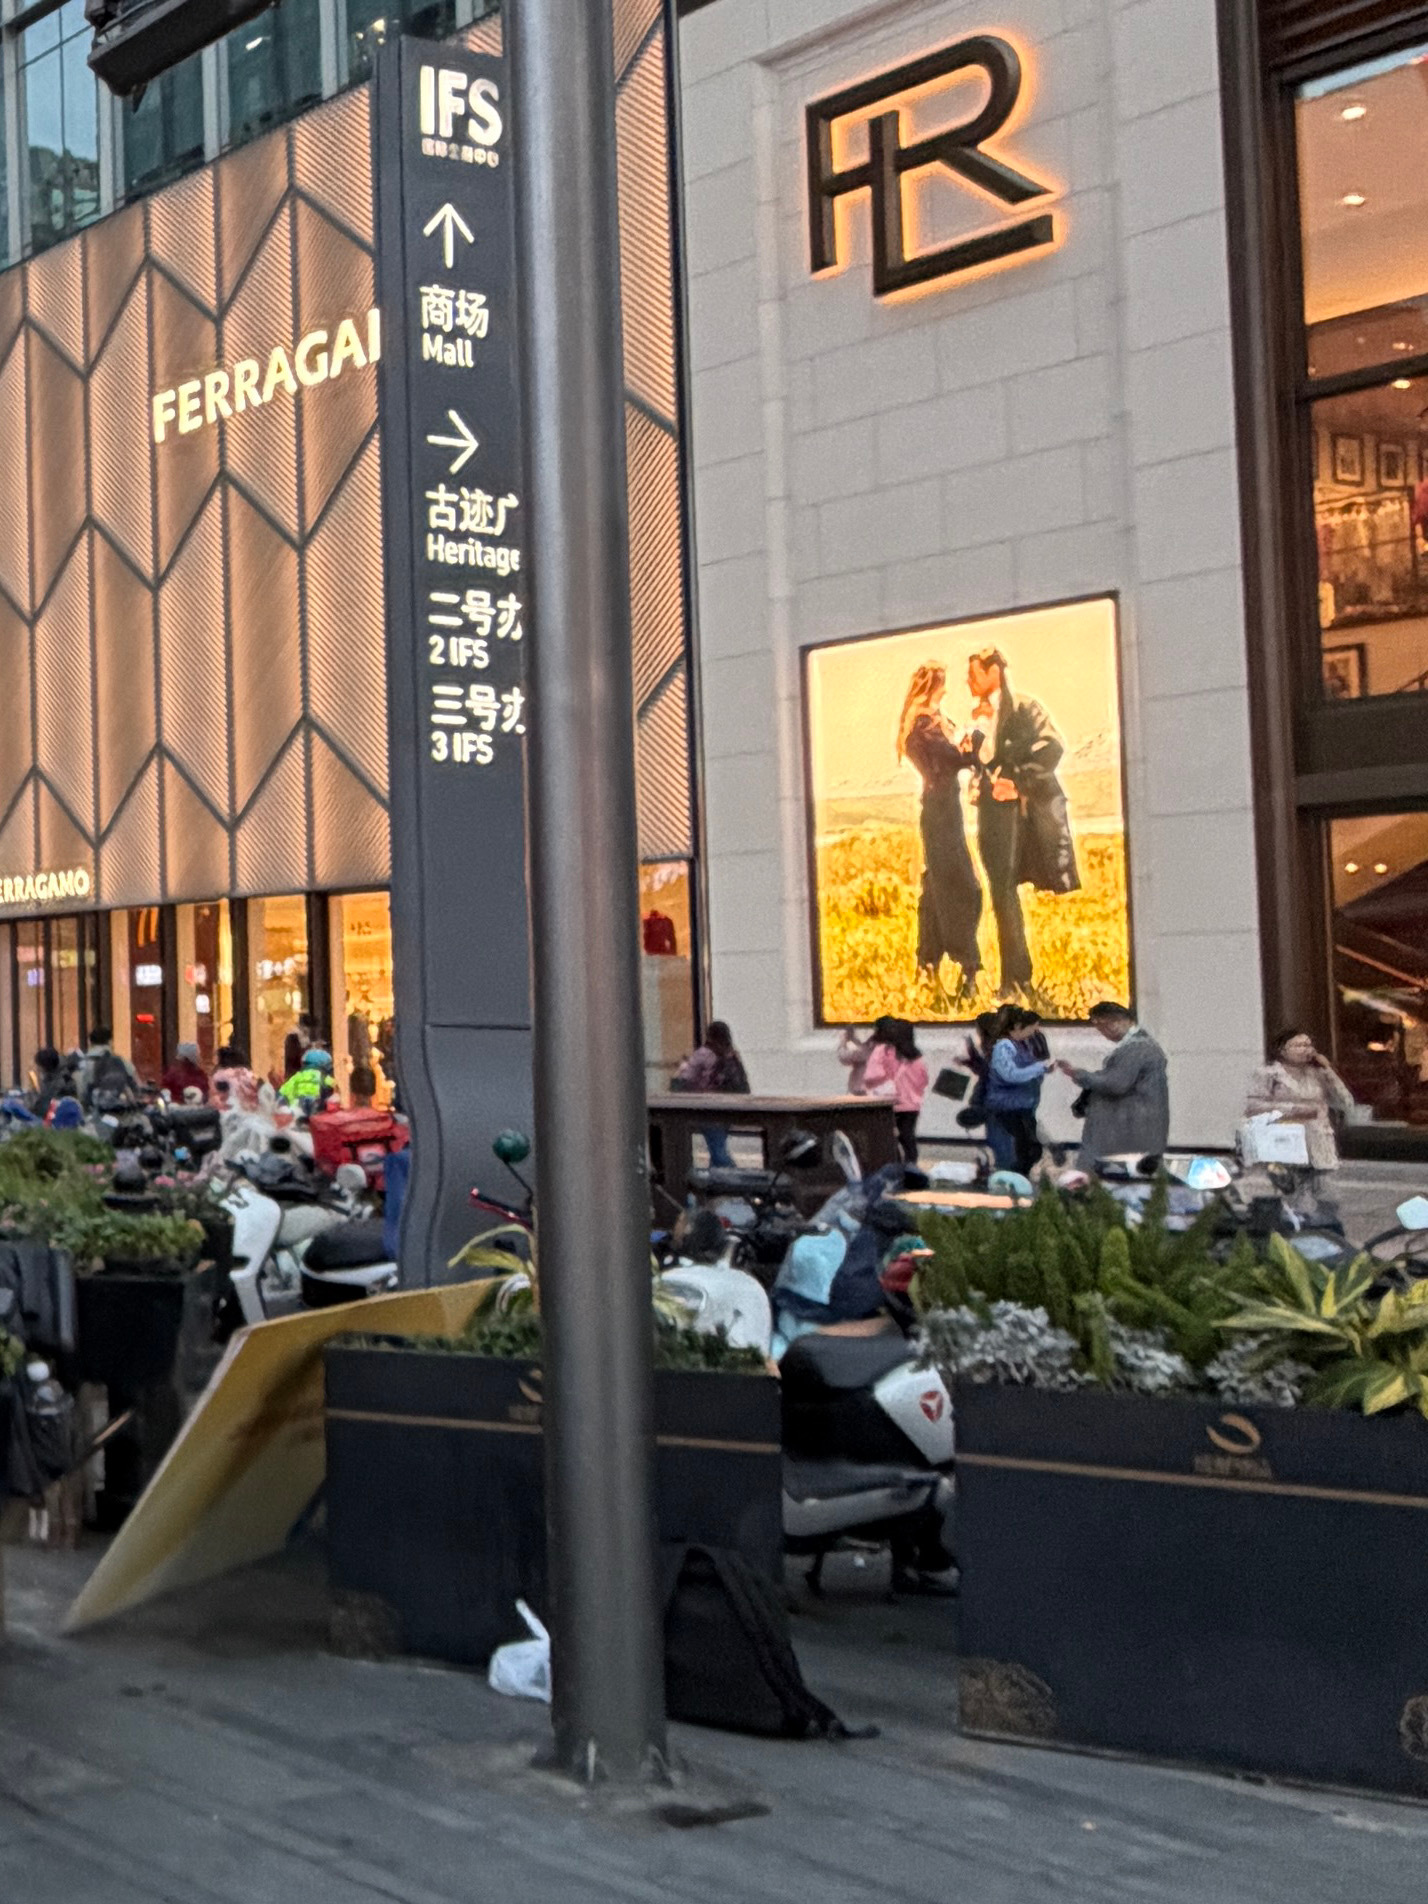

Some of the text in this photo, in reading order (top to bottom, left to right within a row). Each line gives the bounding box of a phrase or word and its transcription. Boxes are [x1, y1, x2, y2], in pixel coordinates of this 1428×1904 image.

[420, 65, 502, 146] IFS
[420, 284, 489, 338] 商场
[422, 332, 474, 367] Mall
[427, 533, 520, 576] Heritage
[429, 635, 490, 669] 2 IFS
[431, 730, 494, 765] 3 IFS
